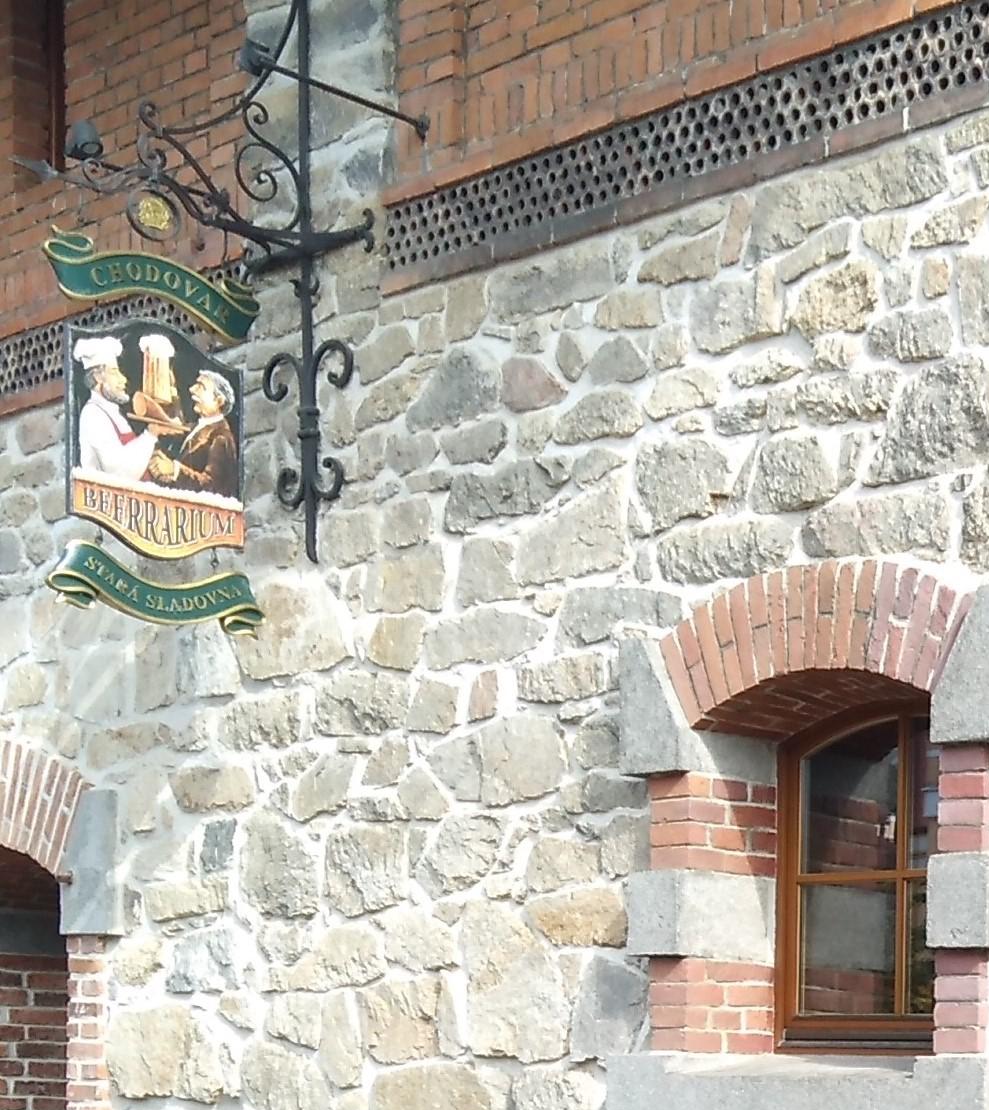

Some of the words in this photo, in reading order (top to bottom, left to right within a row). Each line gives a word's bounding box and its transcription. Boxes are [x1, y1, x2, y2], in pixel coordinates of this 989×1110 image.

[83, 486, 236, 547] BEERRARIUM
[84, 556, 138, 602] STARÁ
[146, 585, 242, 612] SLADOVNA
